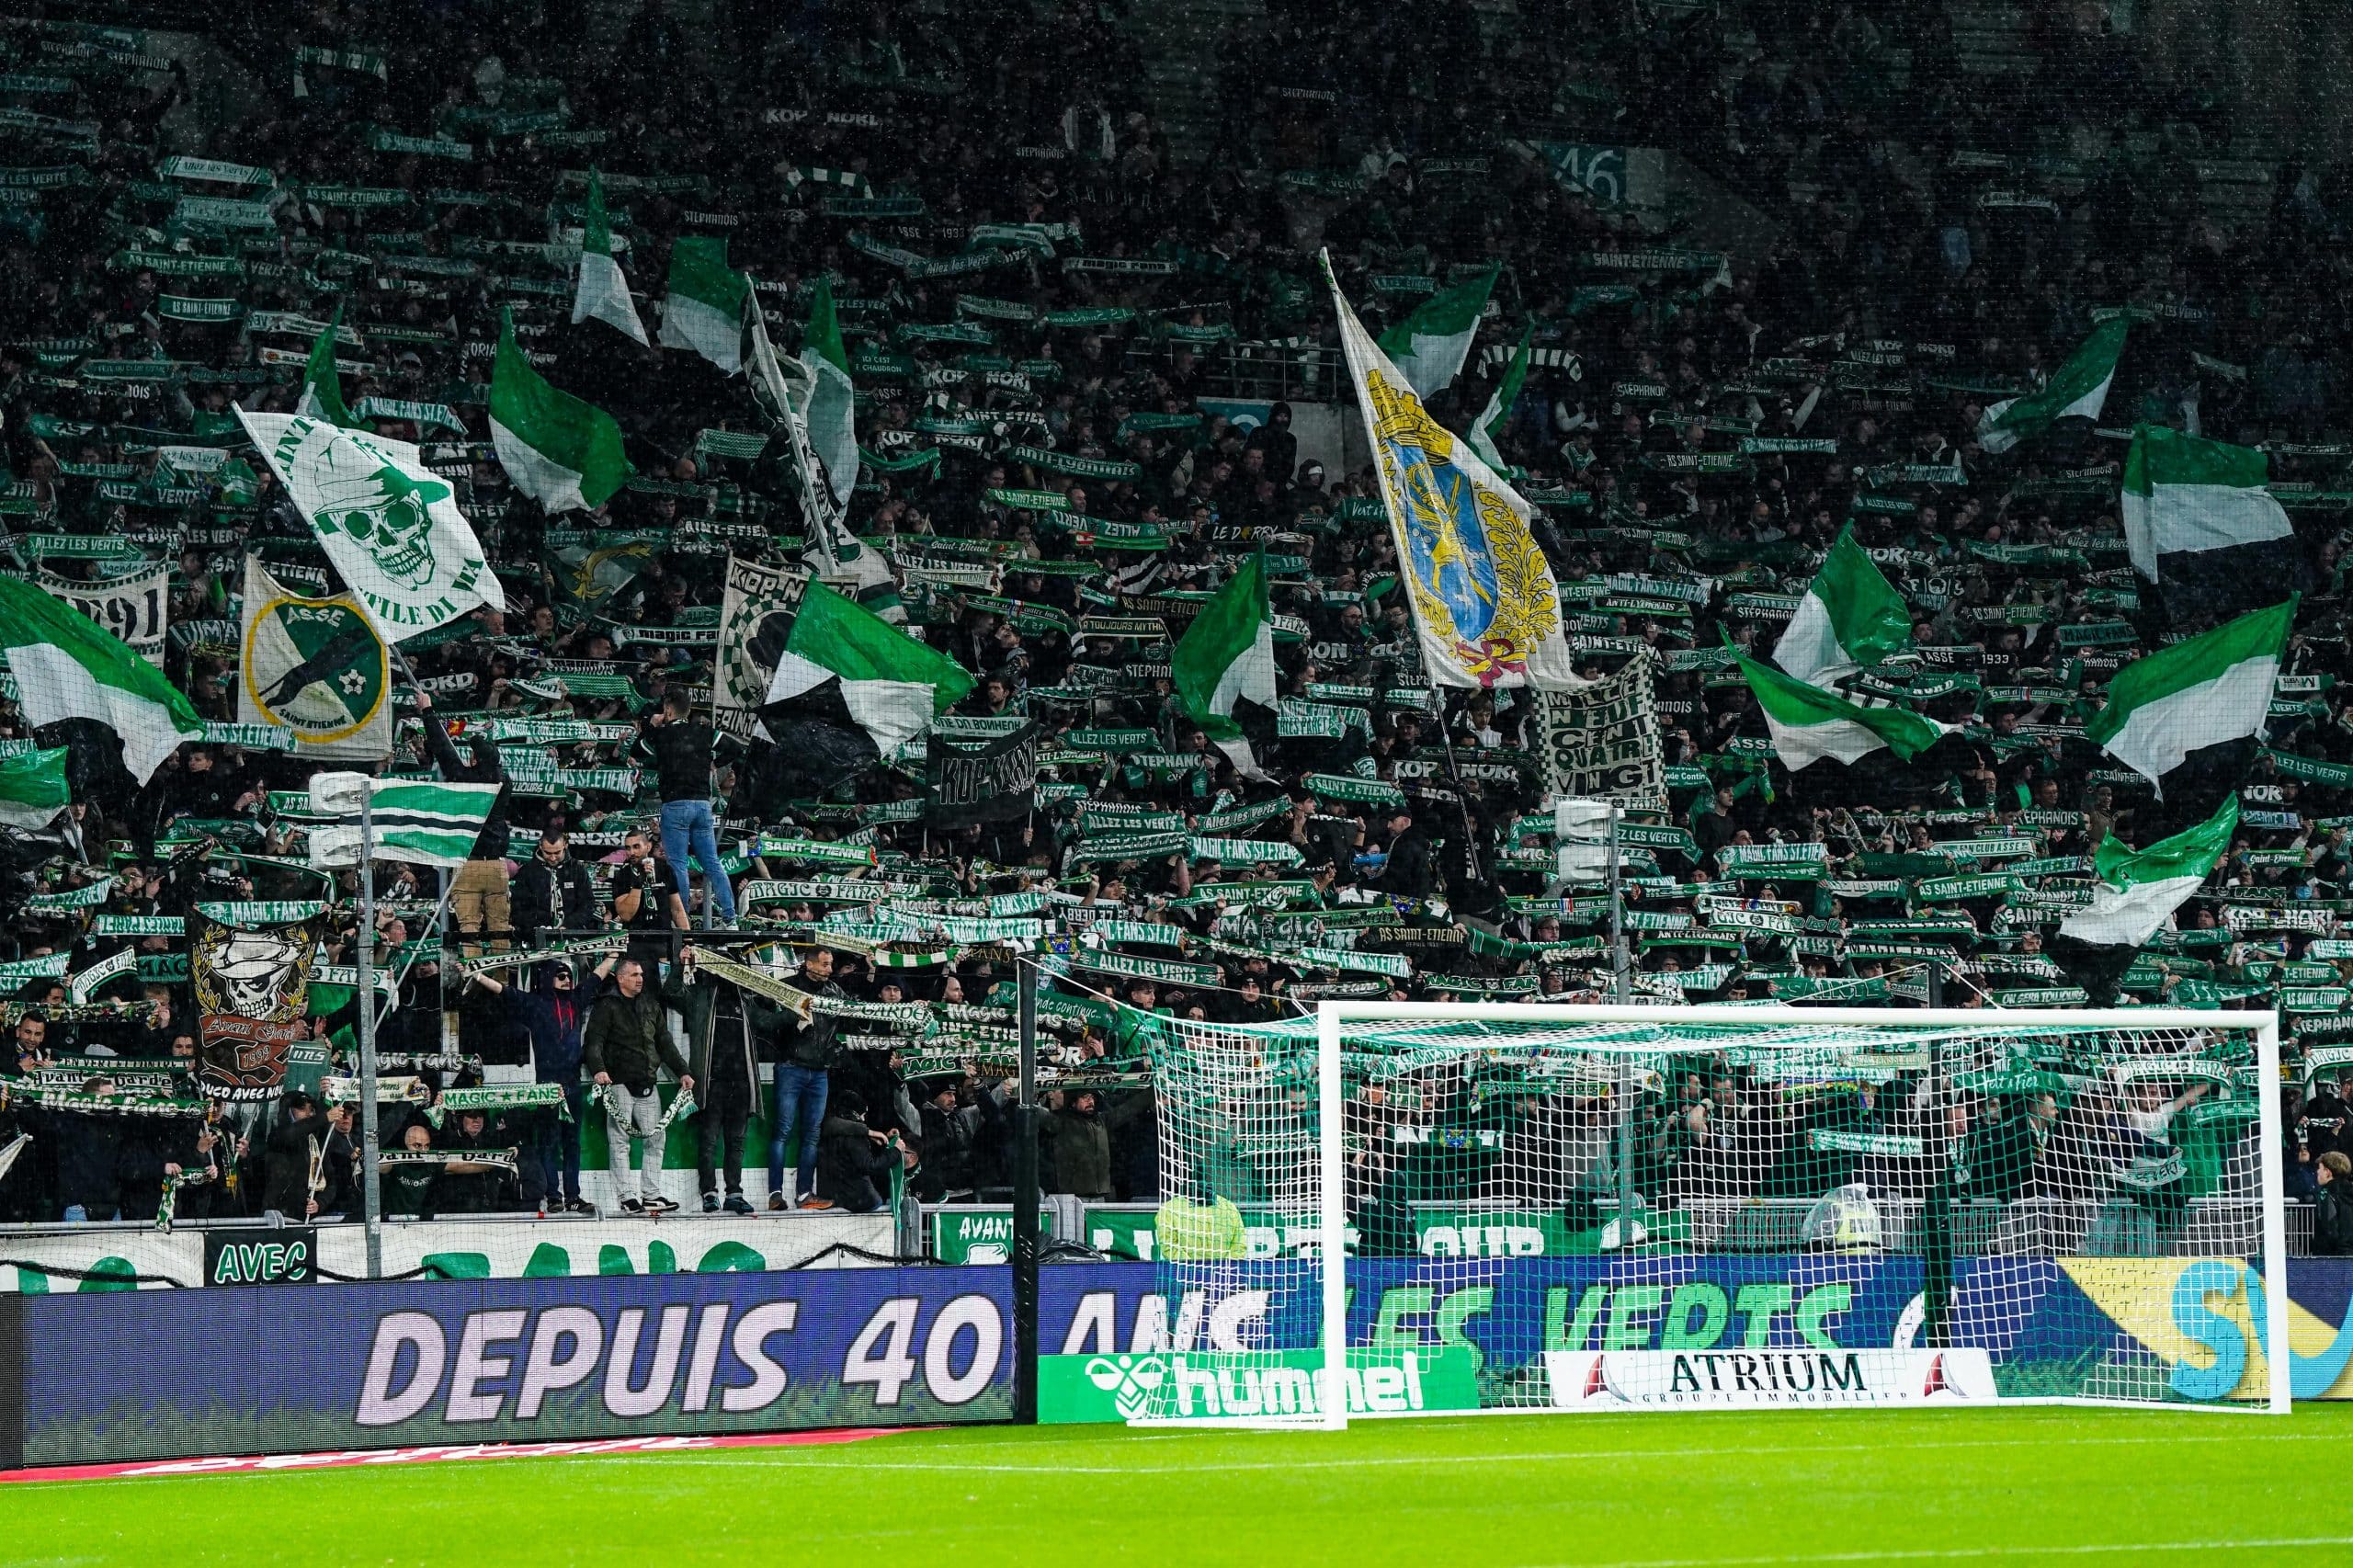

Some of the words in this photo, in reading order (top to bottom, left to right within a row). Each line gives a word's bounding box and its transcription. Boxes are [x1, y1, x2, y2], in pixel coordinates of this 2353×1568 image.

[32, 172, 68, 185] VERTS
[319, 189, 392, 204] SAINT-ETIENNE
[129, 254, 144, 267] AS
[146, 256, 227, 273] SAINT-ETIENNE
[1593, 252, 1686, 270] SAINT-ETIENNE
[182, 301, 233, 316] SAINT-ETIENNE
[863, 365, 902, 373] CHAUDRON
[931, 369, 970, 383] KOP
[1679, 454, 1733, 469] SAINT-ETIENNE
[100, 483, 138, 501] ALLEZ
[995, 489, 1006, 502] AS
[1007, 490, 1069, 507] SAINT-ETIENNE
[186, 529, 210, 544] LES
[1213, 526, 1226, 540] LE
[35, 537, 67, 551] ALLEZ
[69, 538, 88, 551] LES
[90, 539, 126, 552] VERTS
[894, 552, 926, 569] ALLEZ
[927, 557, 948, 570] LES
[729, 562, 775, 603] KOP
[288, 605, 347, 627] ASSE
[426, 596, 459, 625] DI
[1986, 606, 2044, 621] SAINT-ETIENNE
[1092, 619, 1135, 632] TOUJOURS
[1925, 650, 1954, 665] ASSE
[1983, 653, 2009, 665] 1933
[306, 714, 347, 730] ETIENNE
[1550, 699, 1645, 730] NEUF
[1071, 731, 1098, 746] ALLEZ
[1100, 732, 1119, 745] LES
[1120, 731, 1149, 745] VERTS
[1549, 720, 1649, 752] CENT
[1553, 737, 1654, 770] QUATRE
[1394, 761, 1438, 779] KOP
[1554, 761, 1656, 794] VINGT
[2296, 762, 2314, 775] LES
[2316, 766, 2347, 781] VERTS
[941, 757, 988, 805] KOP
[1316, 778, 1346, 793] SAINT
[282, 796, 295, 811] AS
[1087, 814, 1120, 830] ALLEZ
[1122, 815, 1143, 829] LES
[1145, 814, 1178, 831] VERTS
[1233, 810, 1249, 824] les
[2017, 811, 2079, 826] TEPHANOIS
[1630, 830, 1648, 842] LES
[1650, 830, 1681, 844] VERTS
[1194, 836, 1223, 858] MAGIC
[1227, 840, 1251, 860] FANS
[1741, 843, 1769, 862] MAGIC
[1771, 843, 1793, 862] FANS
[1976, 842, 1995, 853] CLUB
[2249, 852, 2302, 866] Saint-Etienne
[749, 881, 811, 902] MAGIC
[1199, 887, 1213, 900] AS
[1216, 886, 1302, 901] SAINT-ETNNE
[1920, 882, 1932, 897] AS
[1934, 876, 2009, 894] SAINT-ETIENNE
[232, 903, 265, 923] MAGIC
[267, 903, 303, 922] FANS
[1380, 926, 1394, 943] AS
[967, 947, 1013, 964] FANS
[1099, 955, 1138, 972] ALLEZ
[1142, 960, 1162, 976] LES
[1166, 962, 1197, 983] VERTS
[2002, 992, 2018, 1006] ON
[2286, 991, 2296, 1004] AS
[204, 1019, 251, 1038] Avant
[2294, 1016, 2353, 1036] STEPHAN
[242, 1045, 272, 1069] 1999
[33, 1068, 84, 1087] Avant
[114, 1071, 173, 1091] Garde
[232, 1085, 265, 1101] AVEC
[445, 1090, 495, 1106] MAGIC
[516, 1086, 560, 1102] FANS
[213, 1243, 308, 1281] AVEC
[355, 1301, 798, 1426] DEPUIS
[842, 1294, 1002, 1406] 40
[1669, 1351, 1869, 1393] ATRIUM
[1171, 1349, 1426, 1416] hummel
[1642, 1392, 1736, 1405] GROUPE
